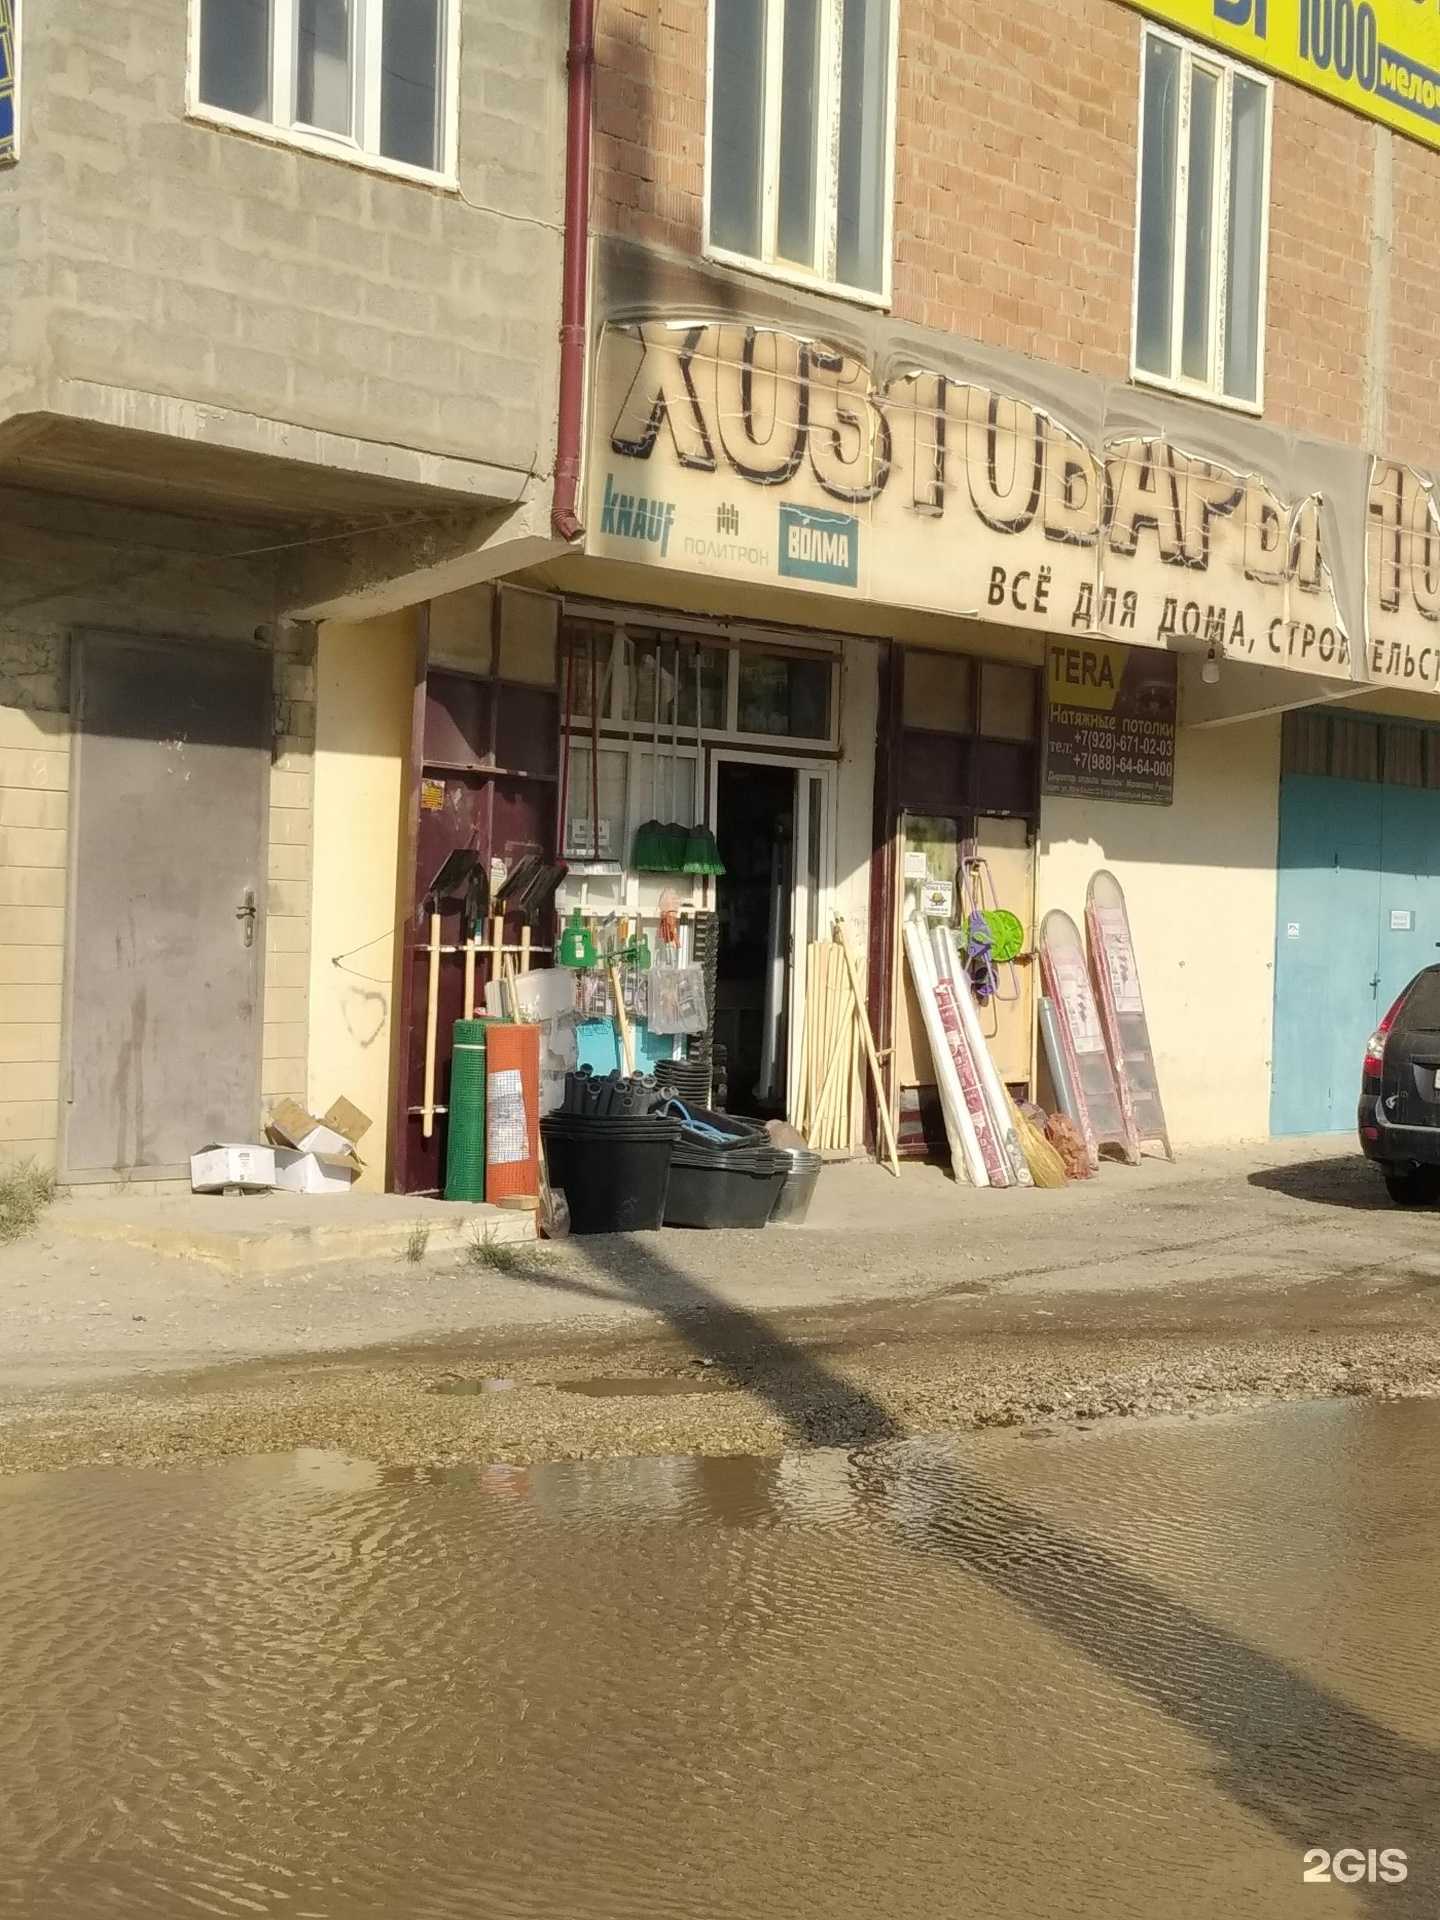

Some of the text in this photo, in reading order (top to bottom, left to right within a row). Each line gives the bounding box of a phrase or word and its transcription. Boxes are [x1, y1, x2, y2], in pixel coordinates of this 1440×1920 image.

[684, 537, 769, 567] ПОЛИТРОН
[788, 526, 849, 568] ВОЛМА
[988, 565, 1052, 614] ВСЁ
[1072, 582, 1137, 629] ДЛЯ
[1051, 646, 1114, 689] TERA
